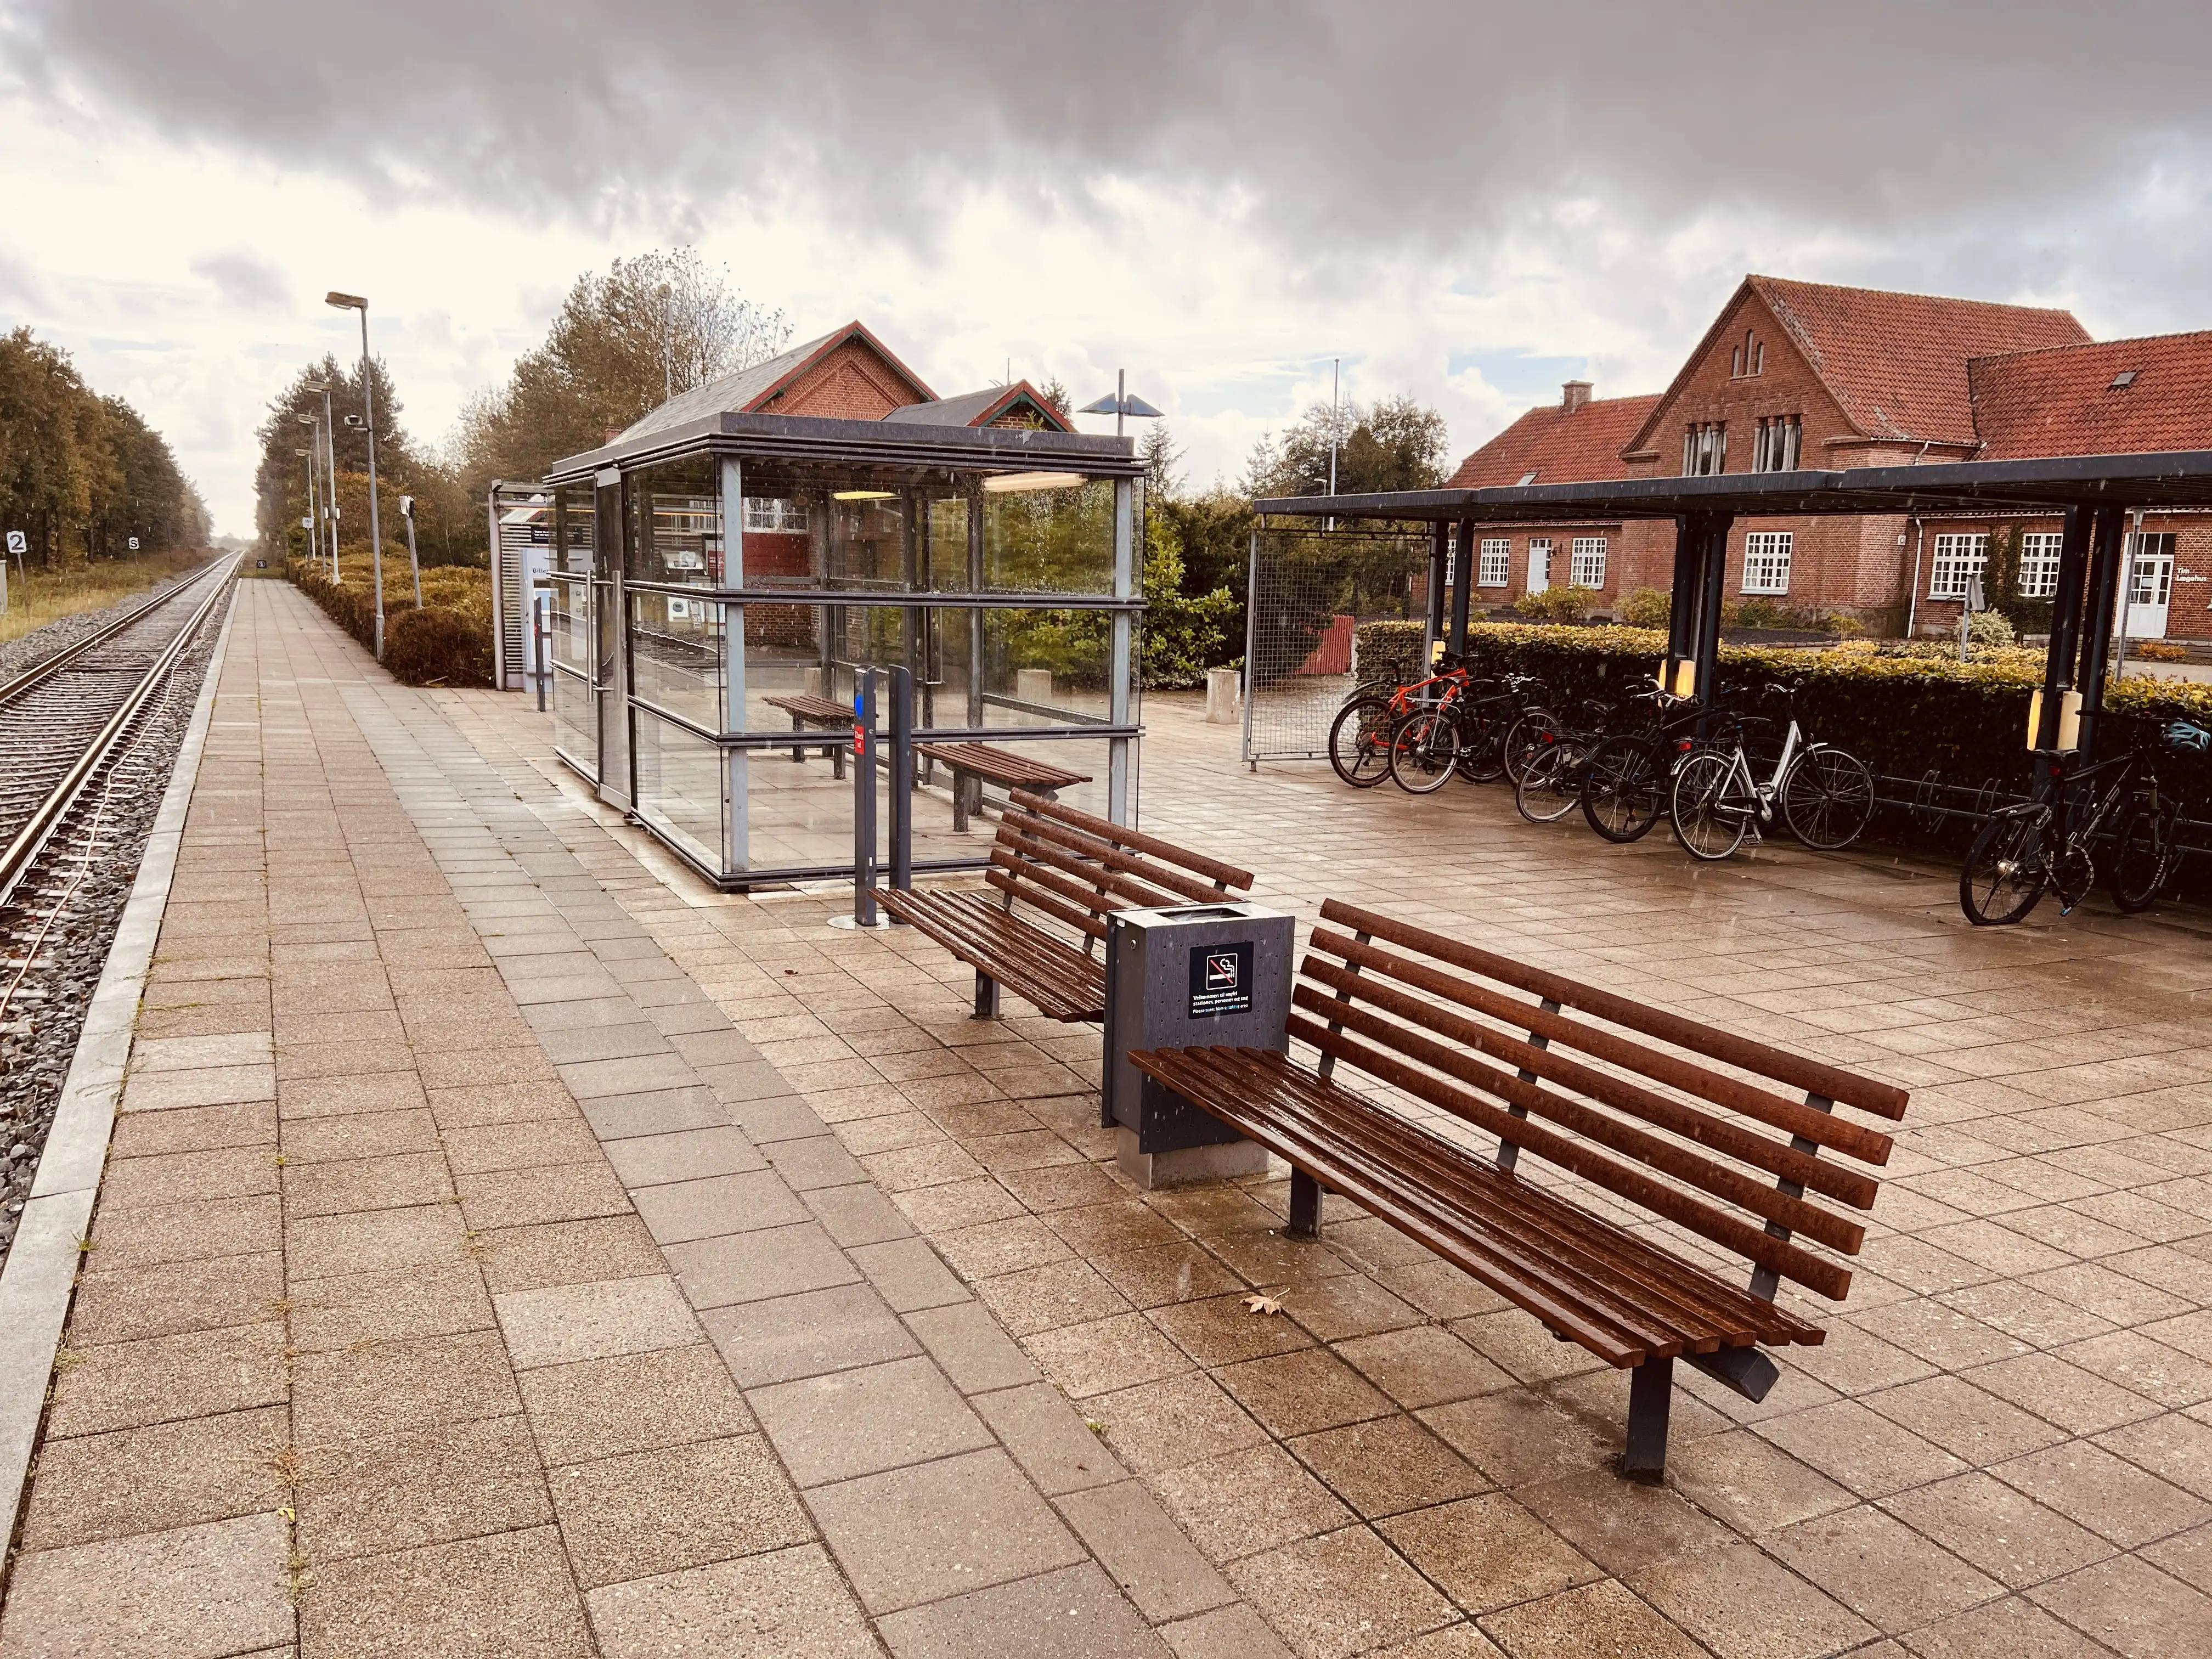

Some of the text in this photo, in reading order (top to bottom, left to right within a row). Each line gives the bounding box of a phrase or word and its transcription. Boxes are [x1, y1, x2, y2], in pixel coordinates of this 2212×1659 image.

[9, 534, 24, 550] 2
[130, 539, 138, 548] S
[2176, 574, 2208, 583] Lægehus
